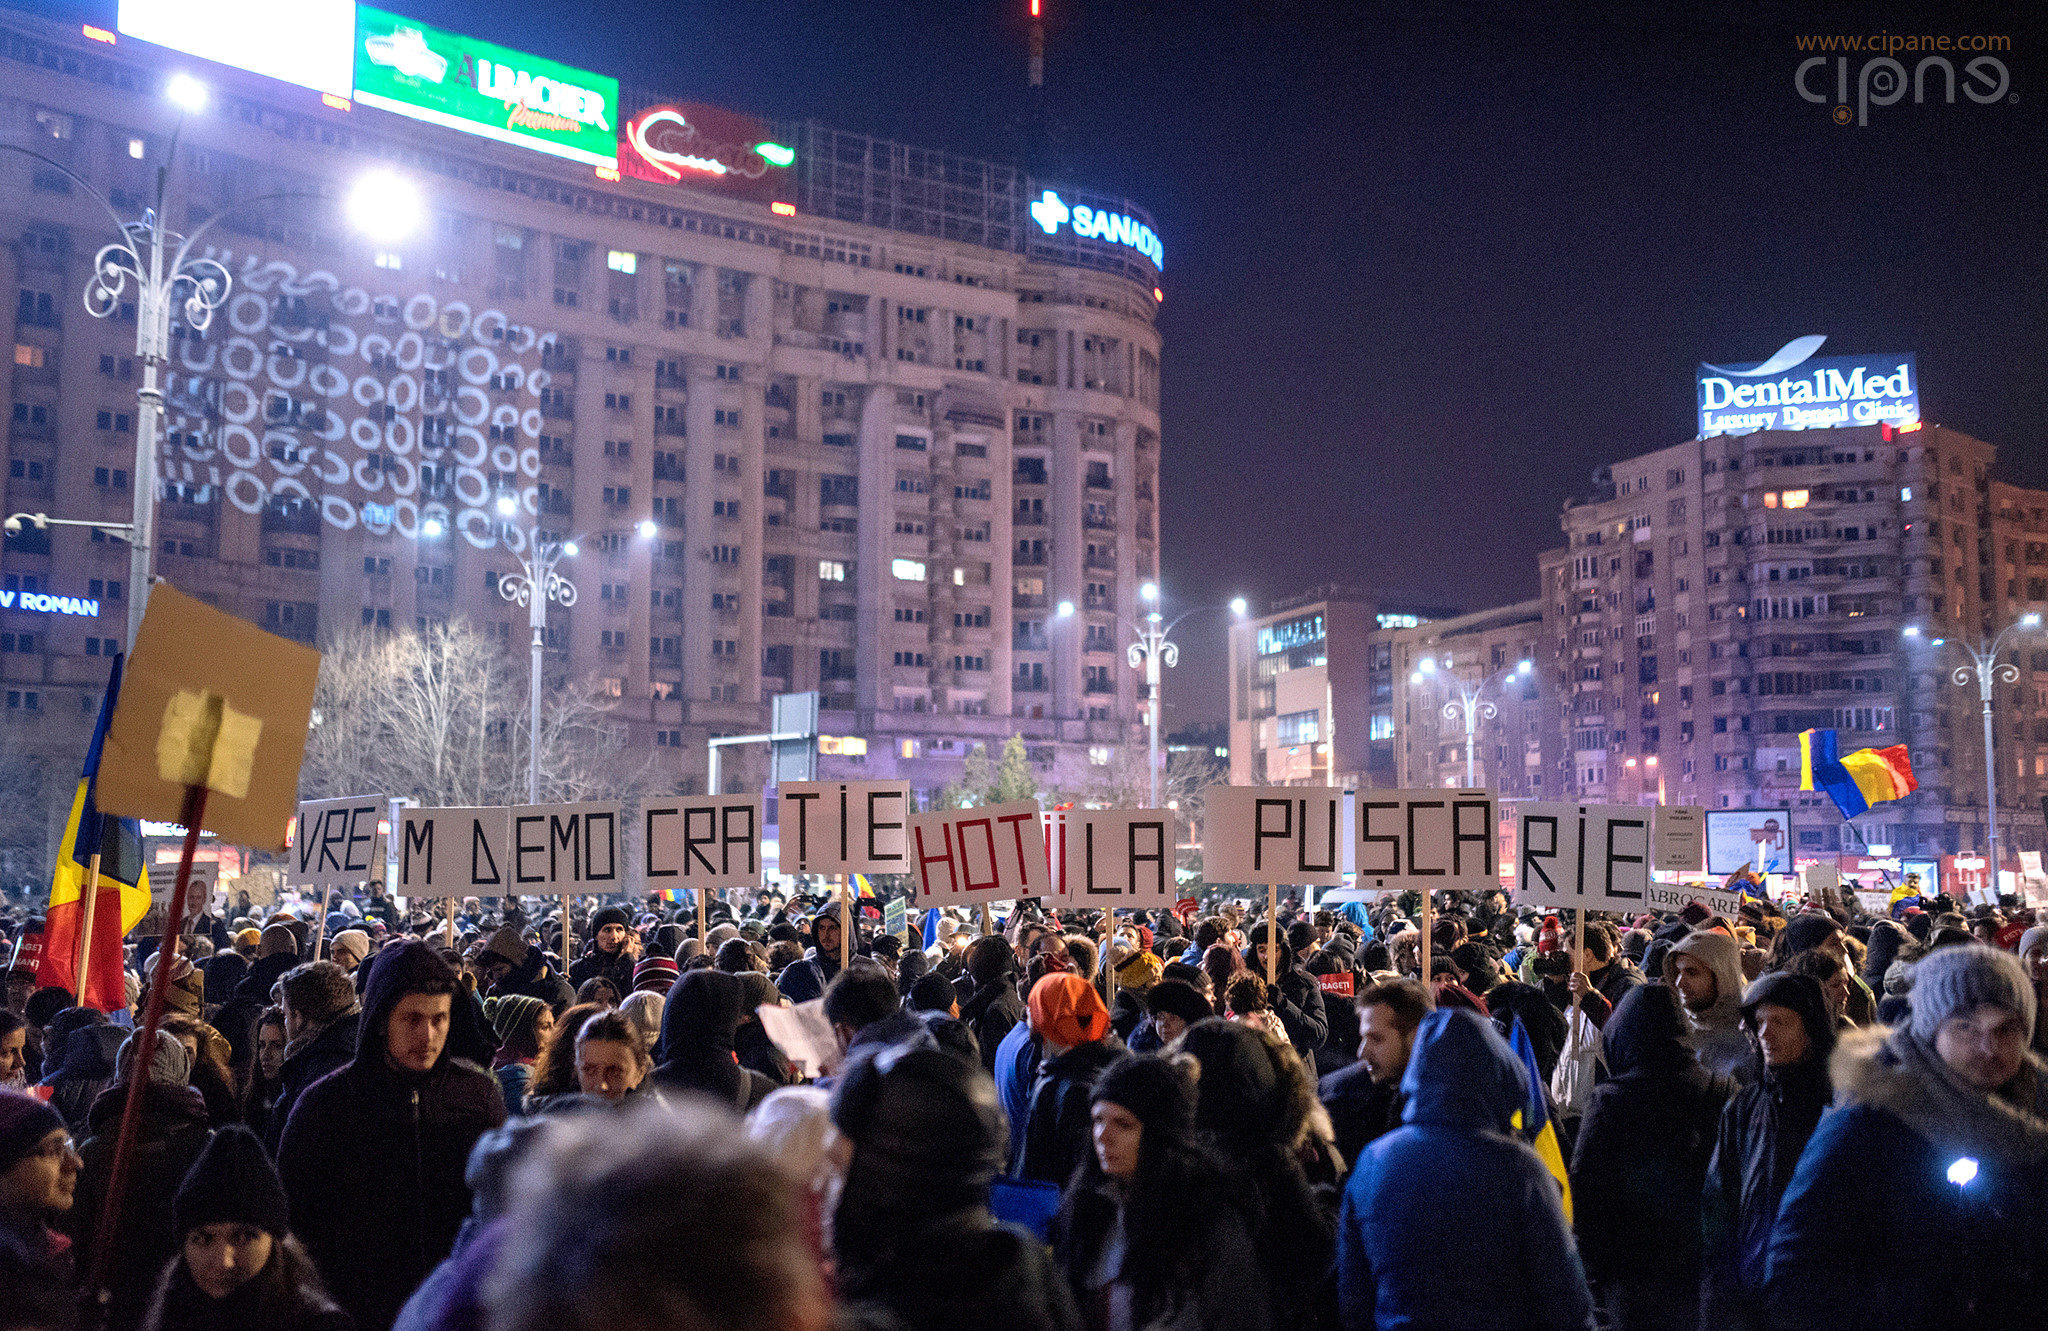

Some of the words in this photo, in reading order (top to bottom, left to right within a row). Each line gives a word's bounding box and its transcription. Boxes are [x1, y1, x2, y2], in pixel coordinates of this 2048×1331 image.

[1701, 364, 1913, 410] DentalMed
[1704, 411, 1777, 430] Luxury
[1783, 403, 1849, 426] Dental
[1853, 400, 1914, 420] Clinic
[20, 592, 99, 617] ROMAN
[1254, 799, 1336, 872] PU
